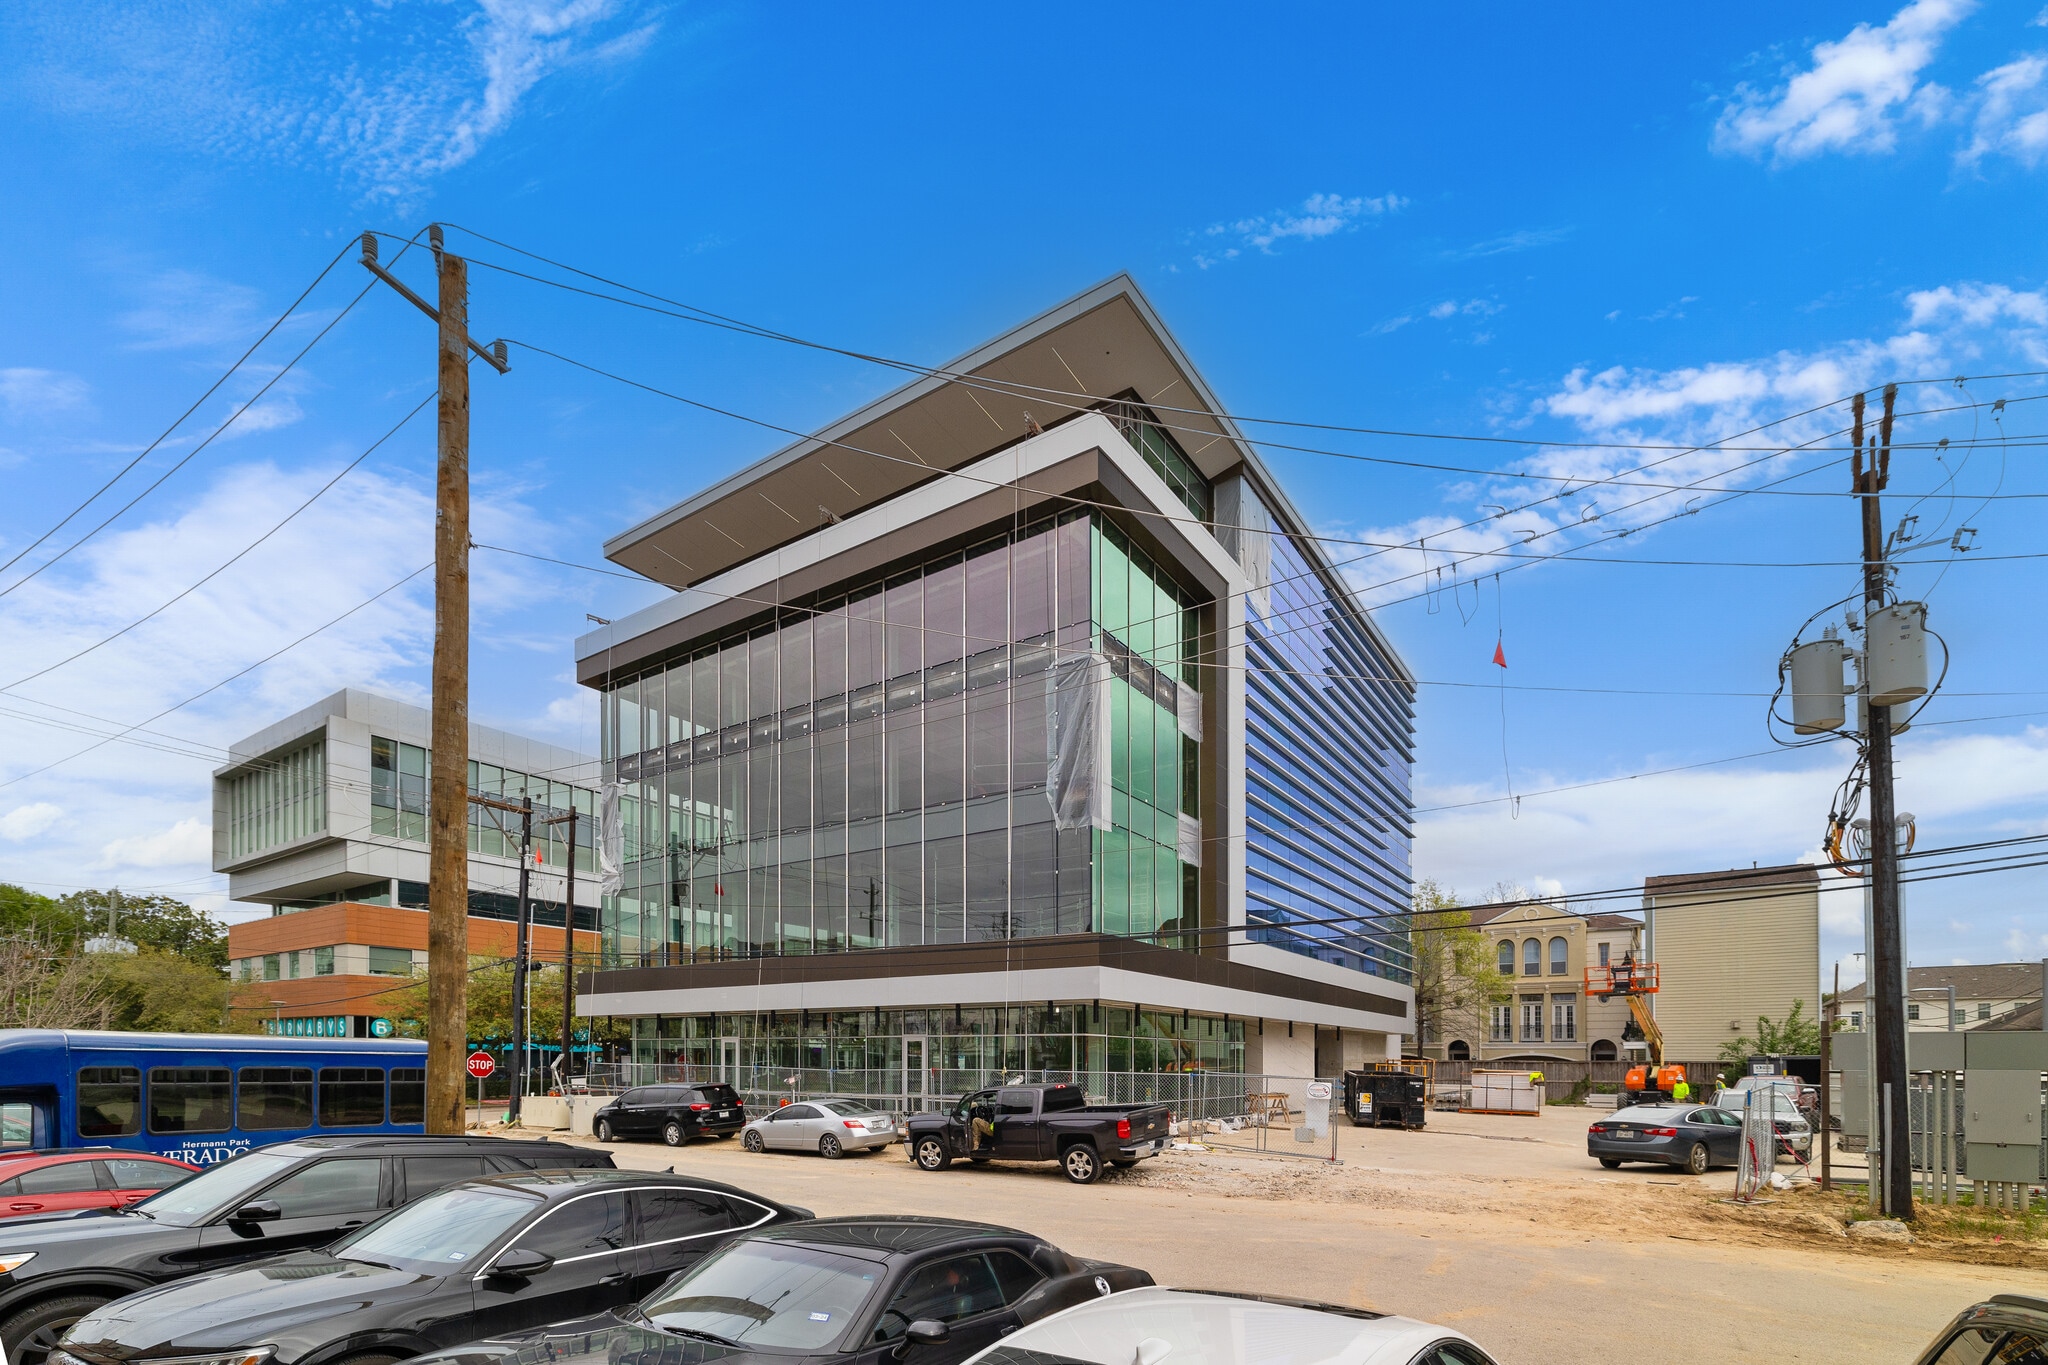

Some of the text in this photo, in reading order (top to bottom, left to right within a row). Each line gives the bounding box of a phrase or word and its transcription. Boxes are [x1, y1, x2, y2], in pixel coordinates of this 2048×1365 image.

[269, 1020, 345, 1035] BARNABYS
[375, 1022, 388, 1035] B
[469, 1060, 493, 1070] STOP
[182, 1139, 251, 1149] Hermann Park
